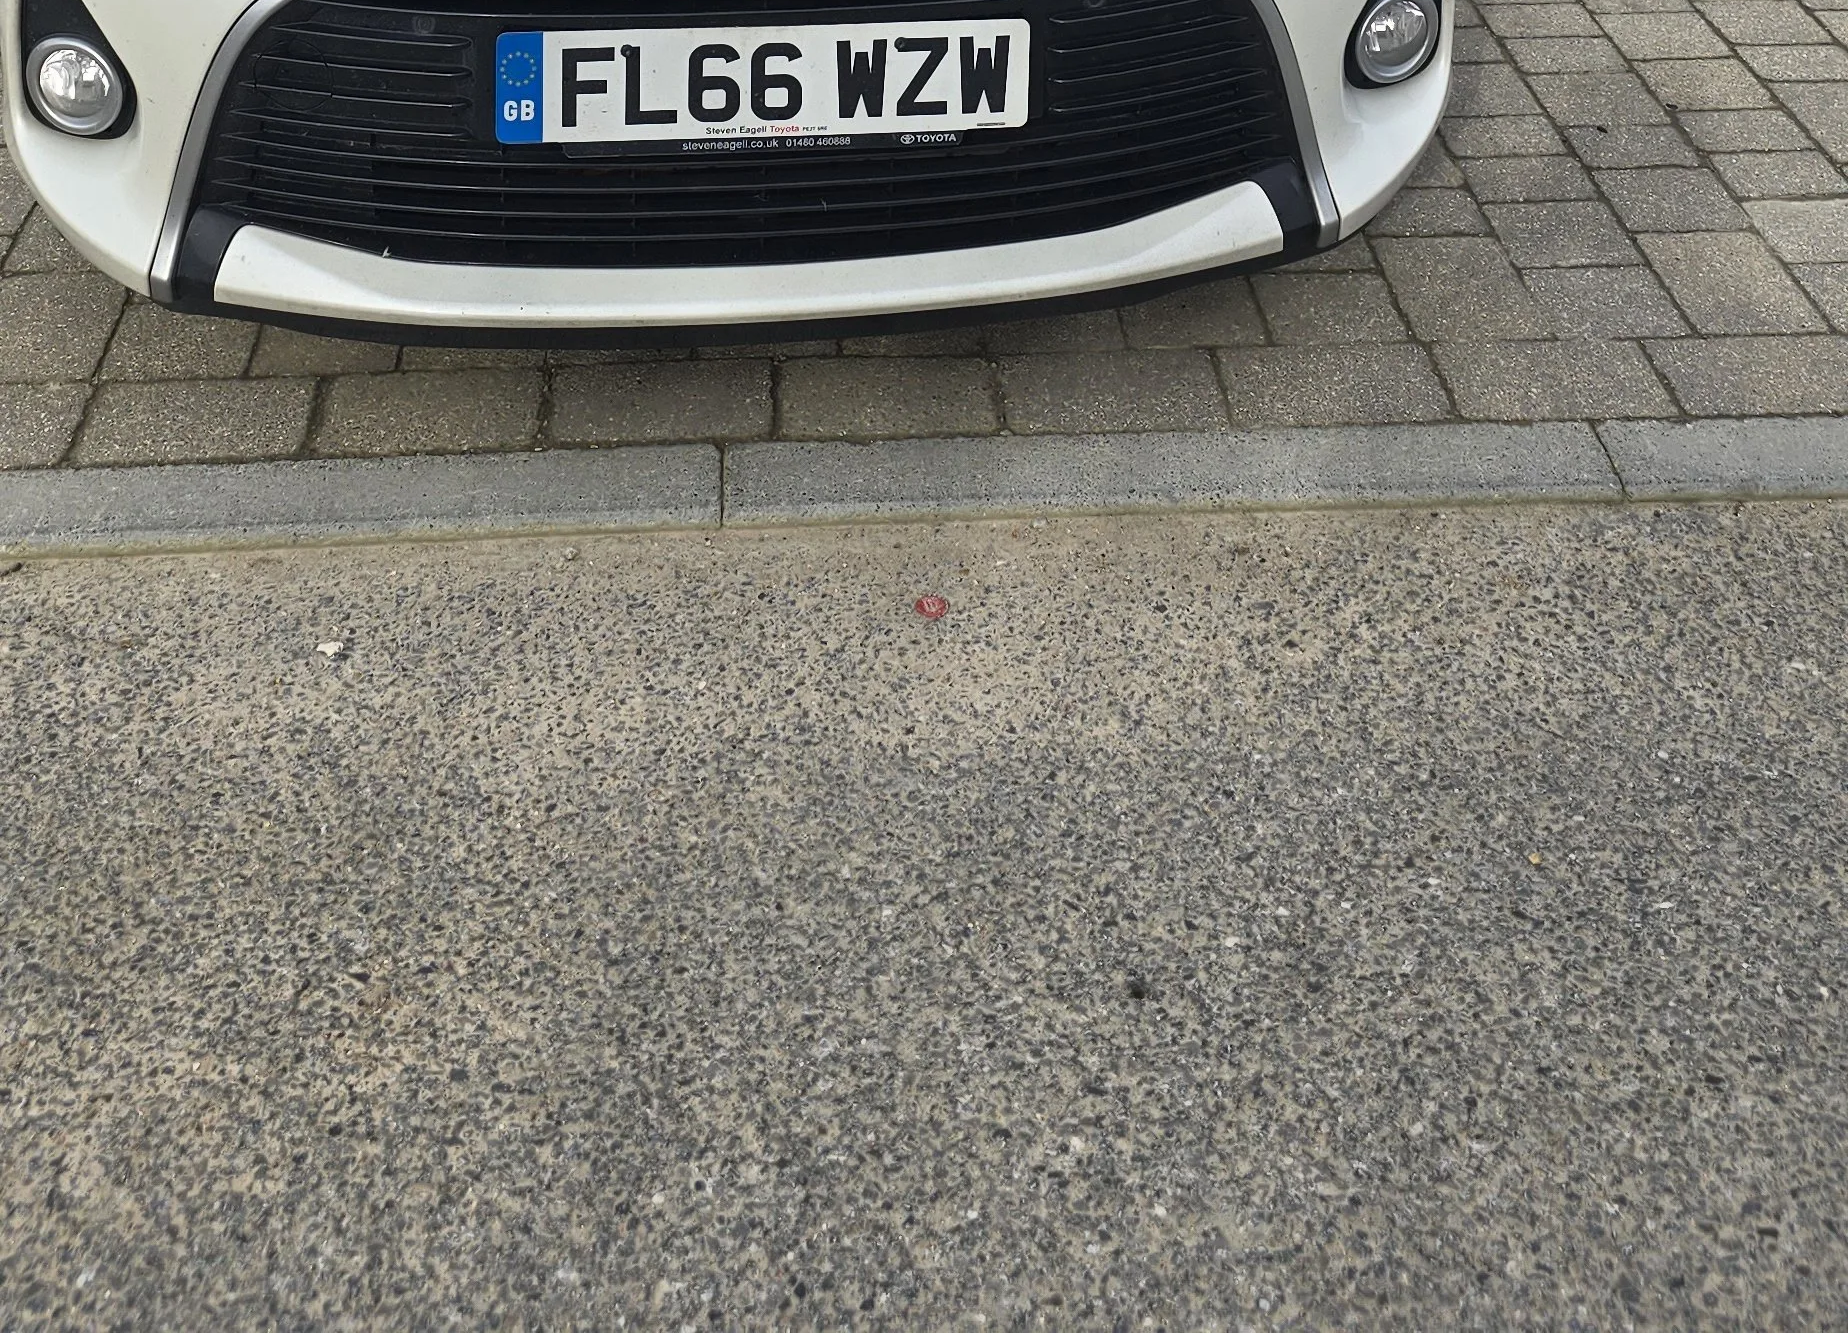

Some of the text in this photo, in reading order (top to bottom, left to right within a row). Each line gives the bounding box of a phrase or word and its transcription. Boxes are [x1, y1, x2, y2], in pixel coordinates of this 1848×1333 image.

[561, 34, 1011, 128] FL66 WZW
[503, 99, 535, 121] GB
[706, 126, 737, 135] Steven
[740, 125, 767, 136] Eagell
[769, 124, 800, 135] Toyota
[682, 138, 779, 151] steveneagell.co.uk
[785, 137, 815, 148] 01480
[915, 133, 957, 143] TOYOTA
